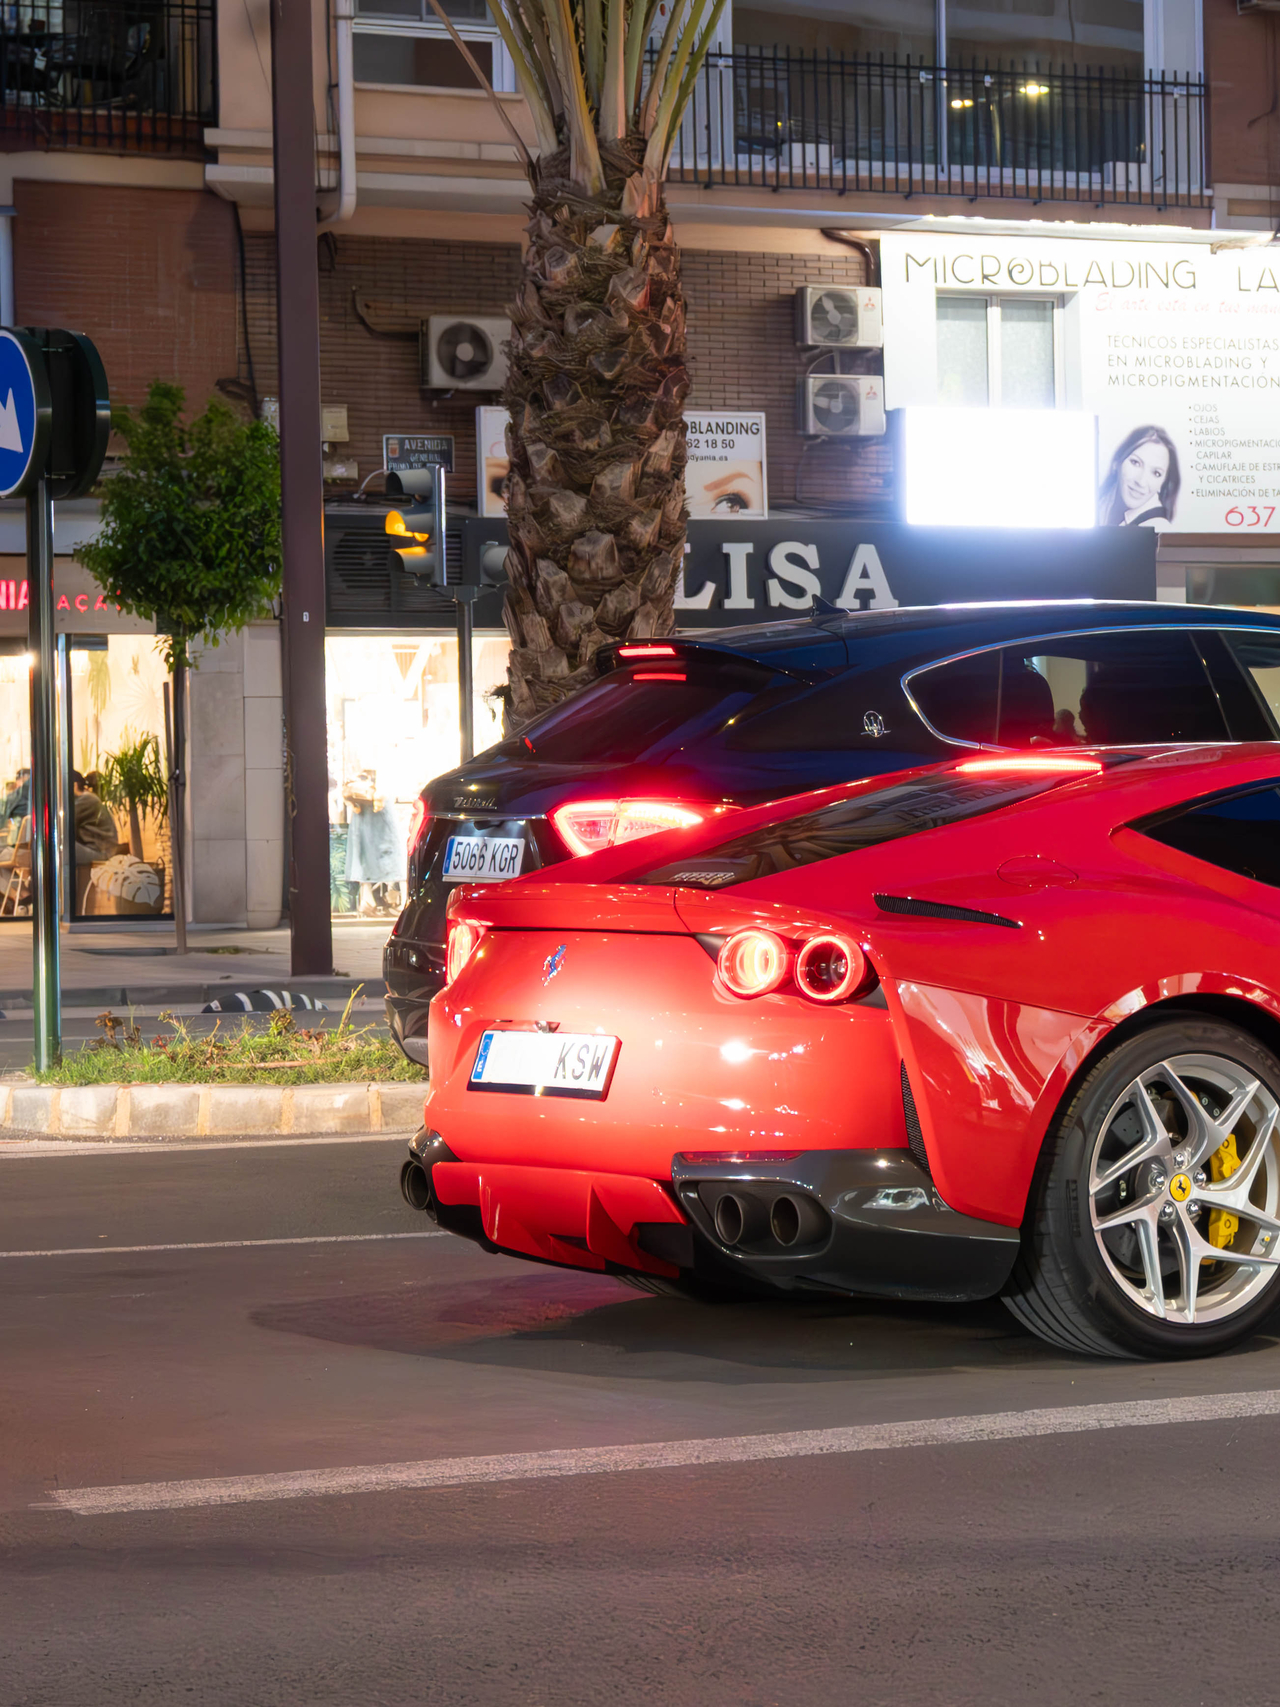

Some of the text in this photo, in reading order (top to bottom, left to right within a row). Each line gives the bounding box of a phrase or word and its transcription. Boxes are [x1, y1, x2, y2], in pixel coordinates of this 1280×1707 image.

[905, 252, 1197, 290] MICROBLADING
[1107, 333, 1280, 351] TÉCNICOS ESPECIALISTAS
[1107, 354, 1268, 370] EN MICROBLADING Y
[1107, 373, 1280, 389] MICROPIGMENTACIÓN
[1193, 403, 1218, 413] OJOS
[1193, 415, 1220, 425] CEJAS
[686, 420, 761, 436] BLANDING
[1193, 427, 1226, 437] LABIOS
[404, 439, 448, 451] AVENIDA
[703, 438, 718, 449] 18
[721, 438, 735, 450] 50
[1196, 450, 1232, 460] CAPILAR
[1195, 462, 1247, 472] CAMUFLAJE
[1249, 462, 1260, 472] DE
[1206, 475, 1256, 484] CICATRICES
[1195, 486, 1256, 498] ELIMINACIÓN
[1258, 488, 1270, 498] DE
[1224, 506, 1276, 528] 637
[453, 841, 520, 874] 5066 KGR
[553, 1042, 609, 1082] KSW
